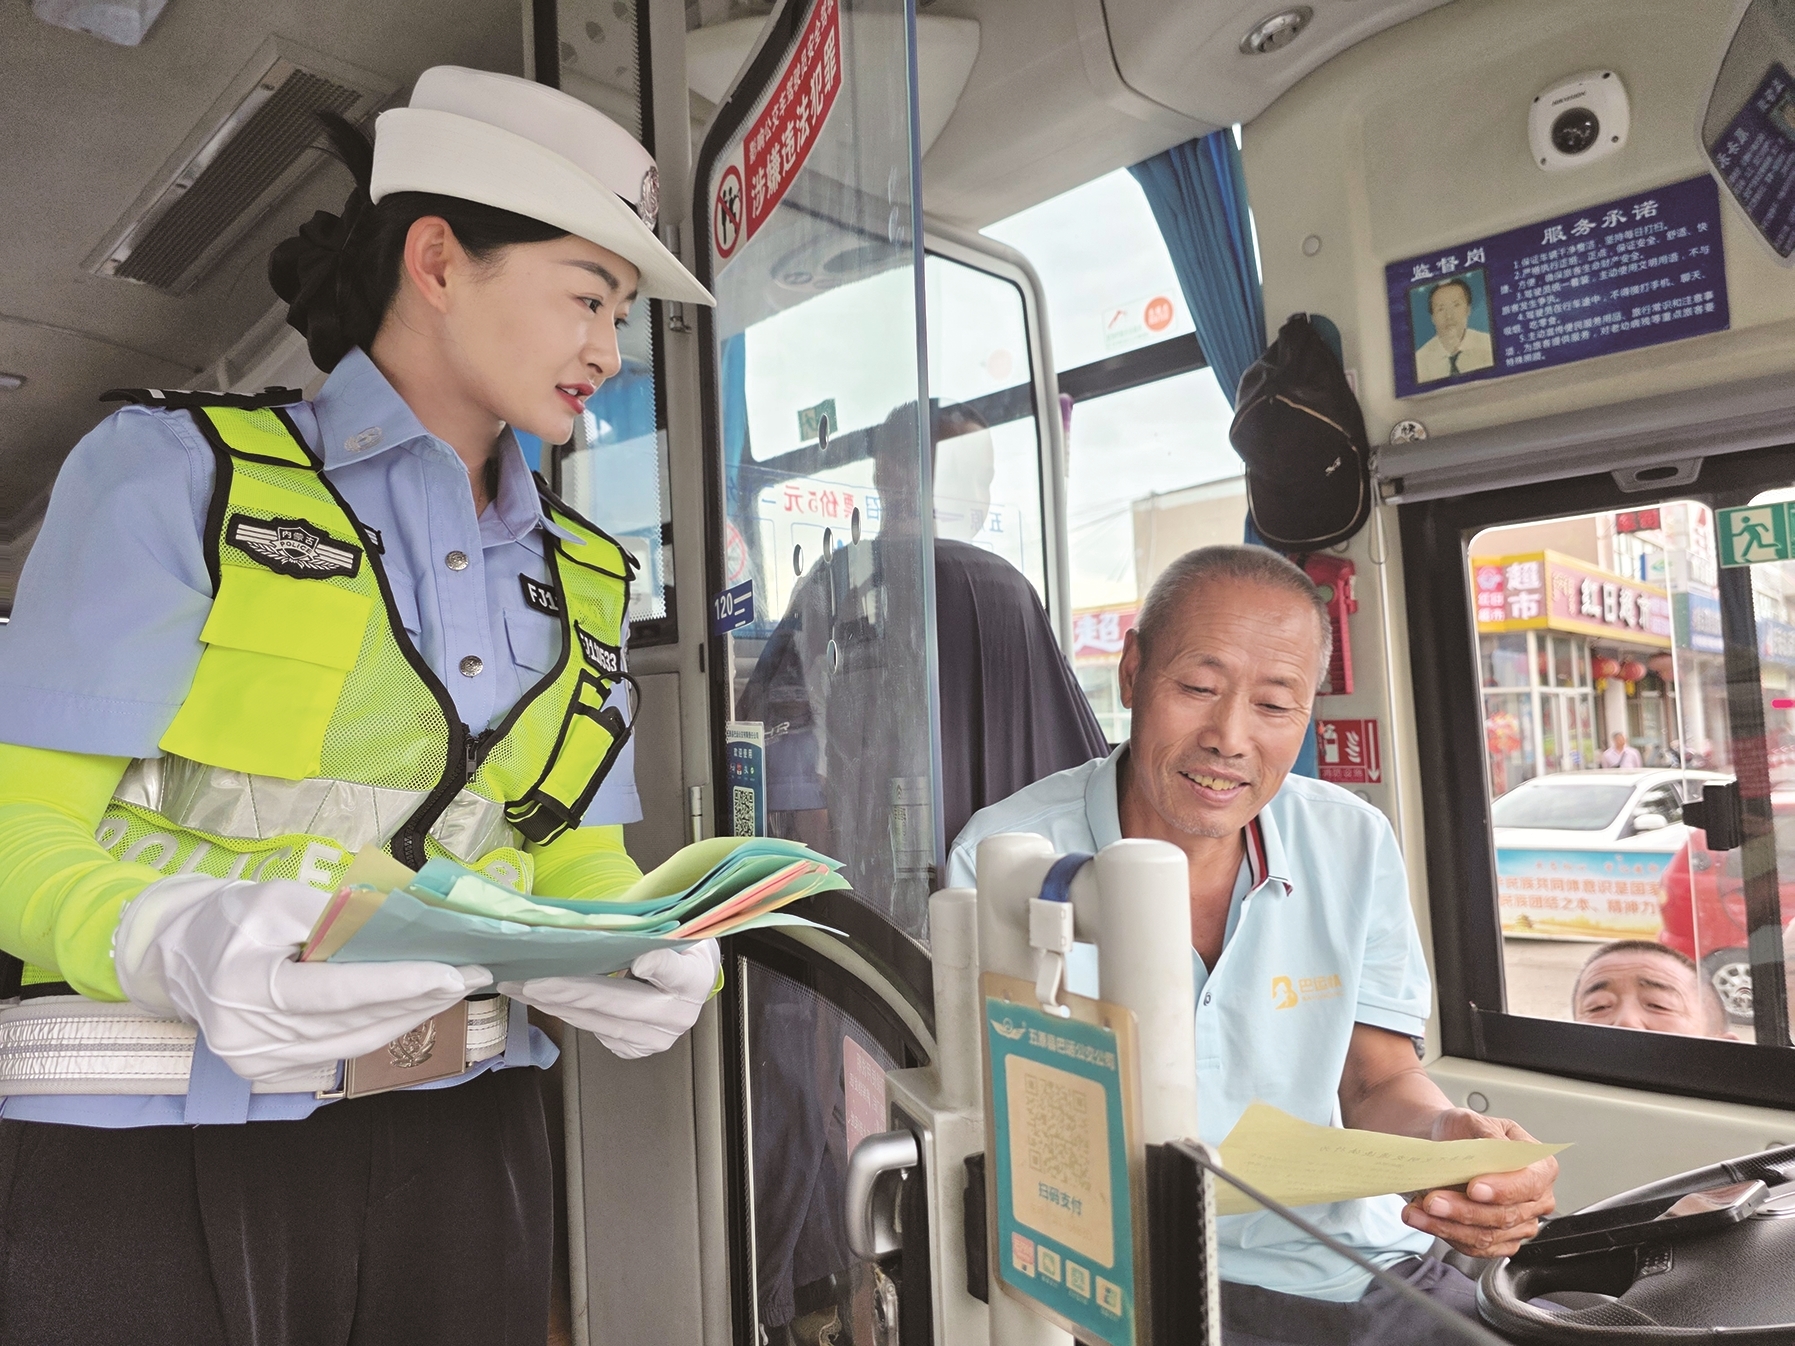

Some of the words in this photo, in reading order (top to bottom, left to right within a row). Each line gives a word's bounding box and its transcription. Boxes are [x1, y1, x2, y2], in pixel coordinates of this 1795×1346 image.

[751, 24, 836, 219] 涉嫌违法犯罪
[1540, 198, 1659, 247] 服务承诺
[1409, 245, 1486, 283] 监督岗
[280, 541, 312, 553] POLICE
[282, 530, 315, 546] 内蒙古
[527, 583, 559, 611] FJ1
[714, 592, 733, 620] 120
[1505, 561, 1543, 620] 超市
[1038, 1181, 1083, 1217] 扫码支付
